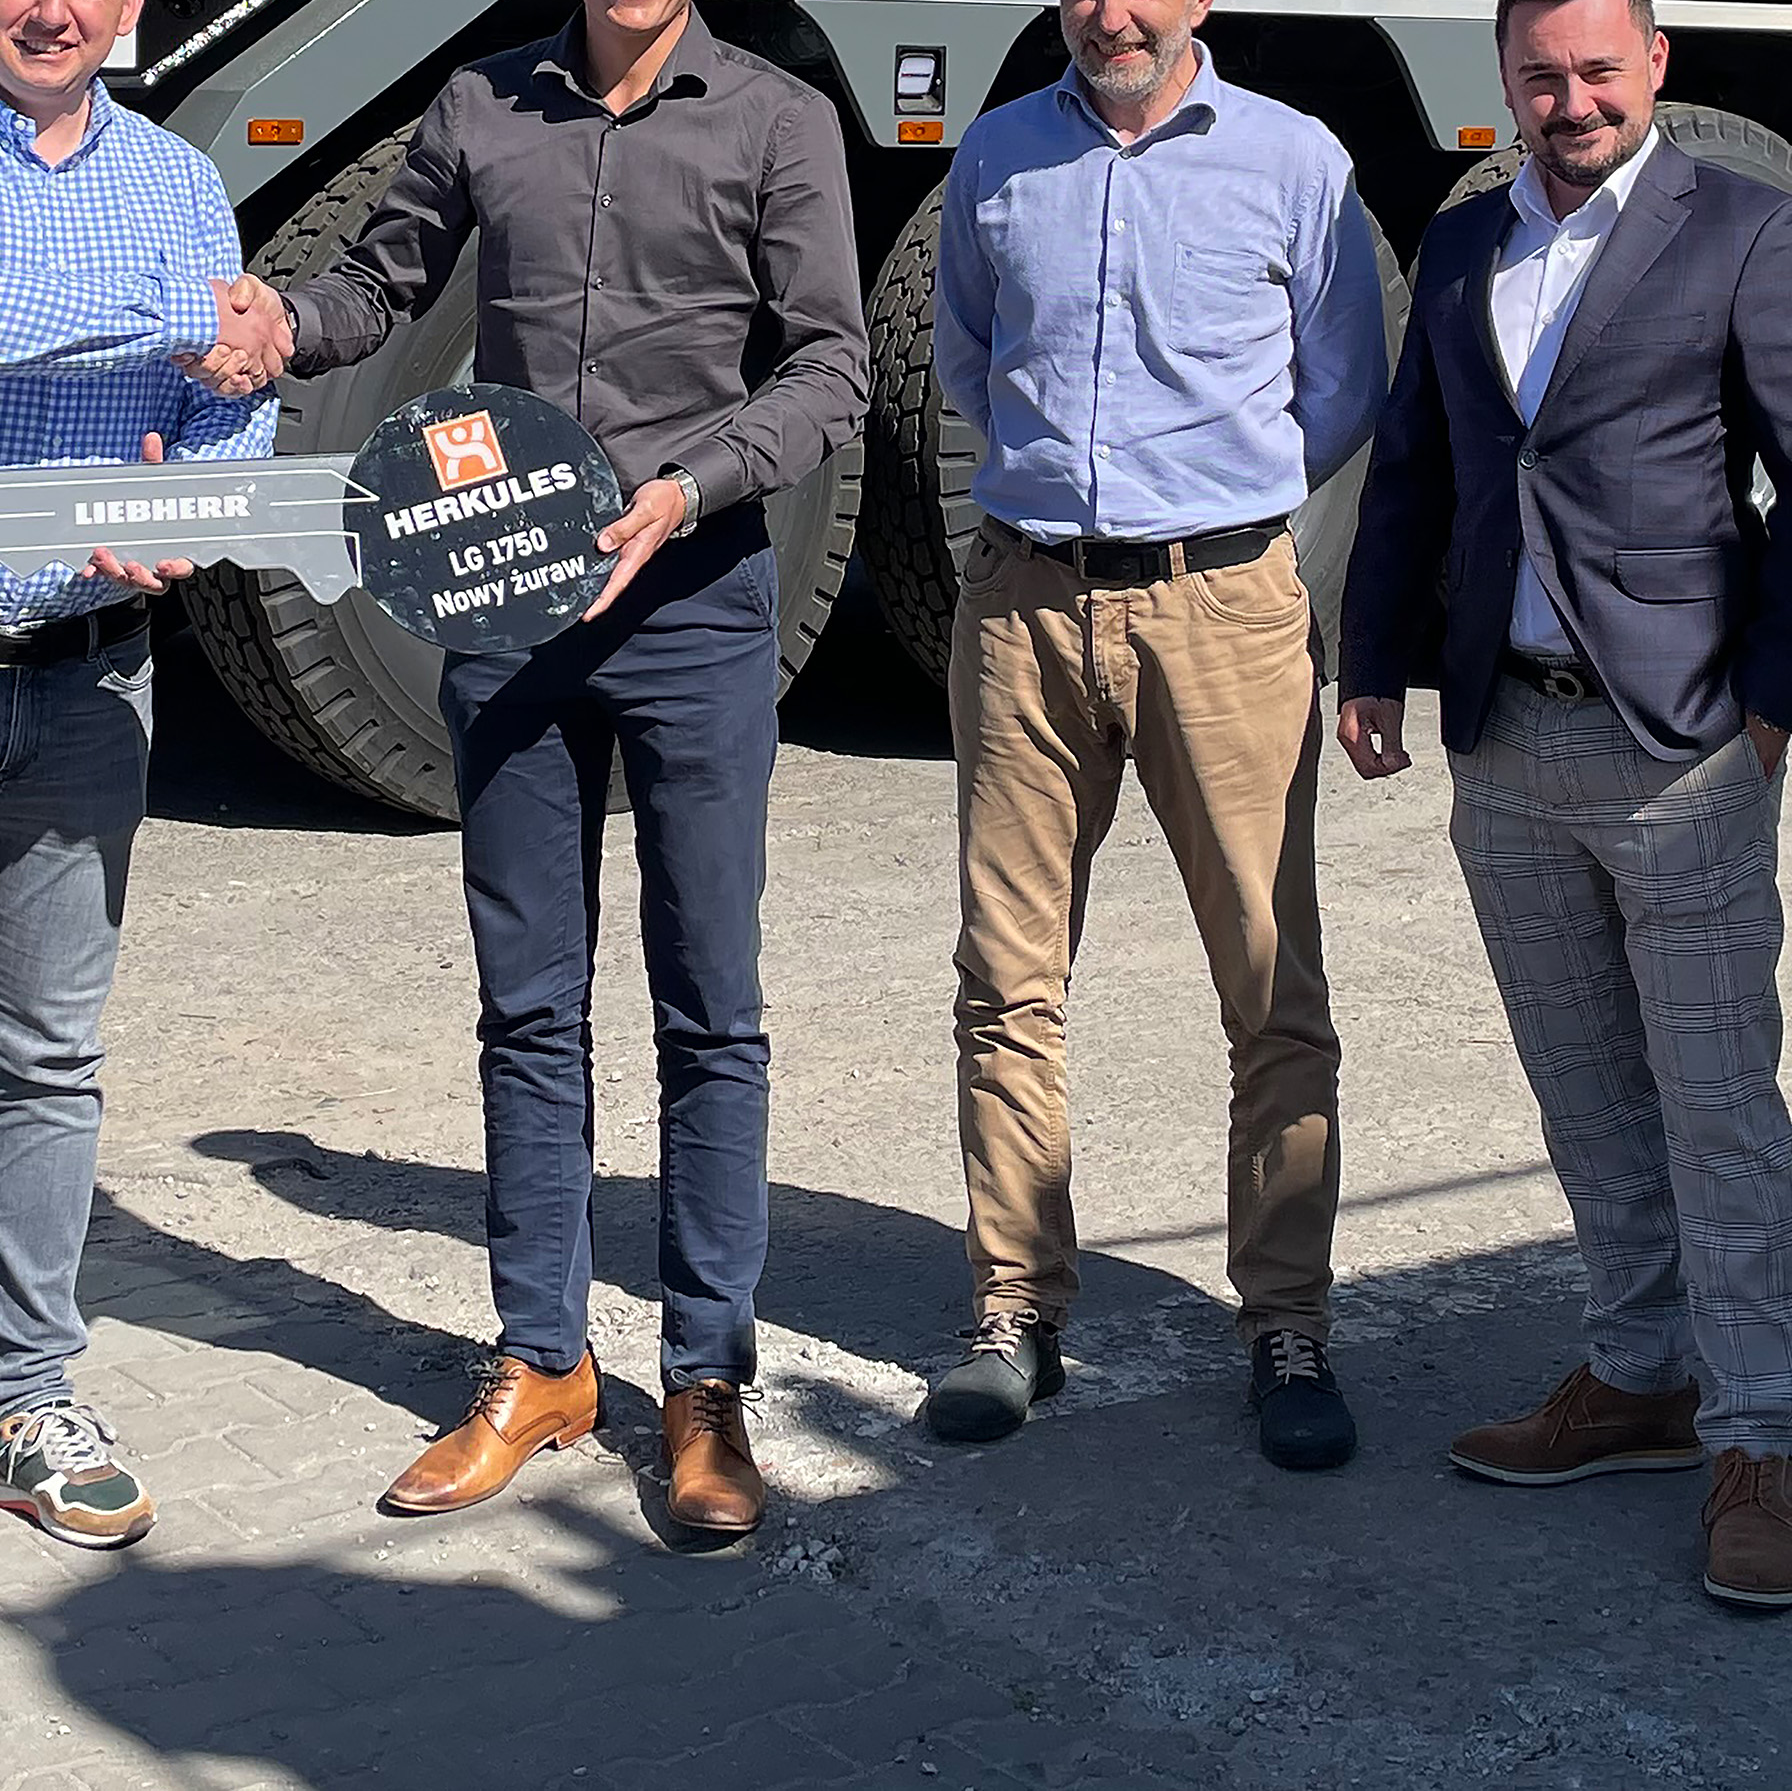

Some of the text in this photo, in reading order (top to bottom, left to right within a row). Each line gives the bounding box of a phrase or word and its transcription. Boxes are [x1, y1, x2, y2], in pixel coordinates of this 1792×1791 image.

[73, 493, 252, 526] LIEBHERR
[382, 461, 578, 541] HERKULES
[448, 525, 549, 578] LG 1750
[431, 553, 587, 620] Nowy żuraw
